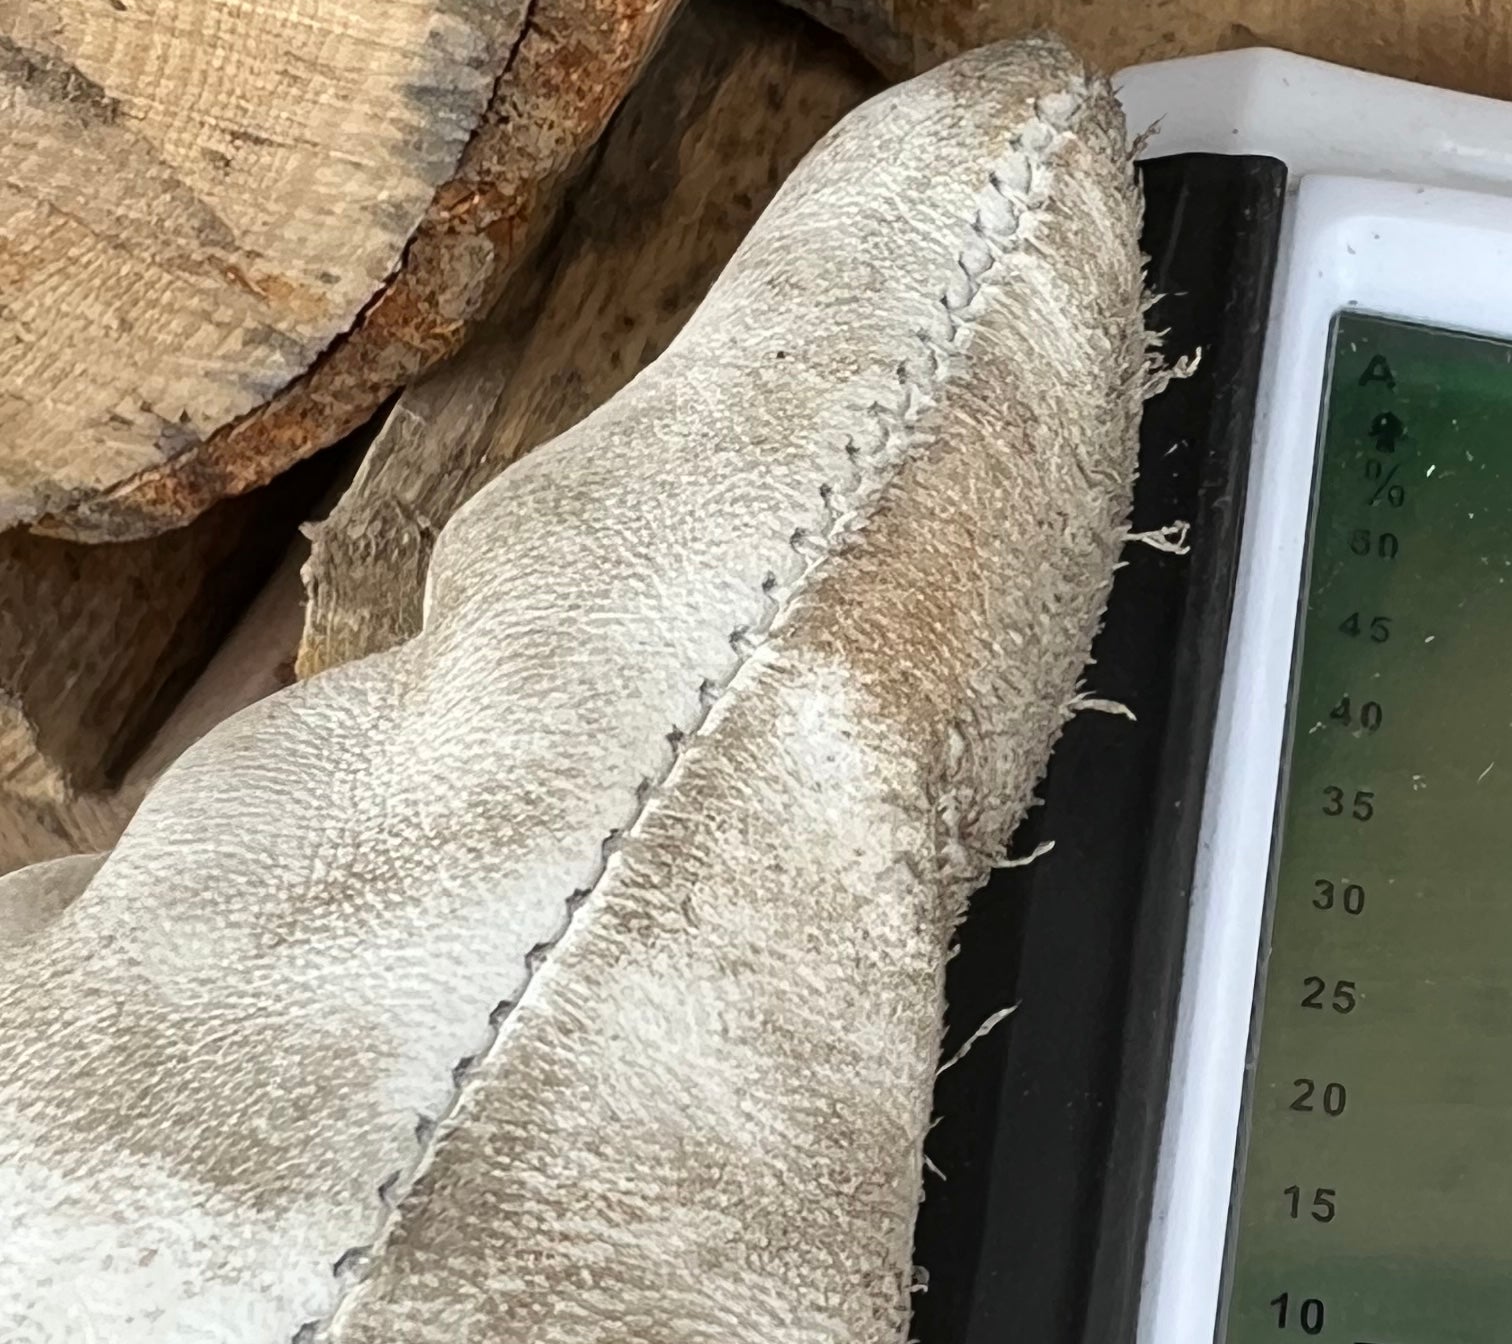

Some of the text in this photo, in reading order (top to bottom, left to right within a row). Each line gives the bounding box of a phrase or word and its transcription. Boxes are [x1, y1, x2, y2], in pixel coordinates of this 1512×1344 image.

[1358, 353, 1397, 390] A
[1338, 612, 1393, 644] 45
[1329, 695, 1384, 736] 40
[1321, 785, 1376, 823] 35
[1311, 878, 1365, 916] 30
[1300, 975, 1357, 1015] 25
[1288, 1077, 1348, 1117] 20
[1283, 1185, 1337, 1224] 15
[1269, 1291, 1326, 1336] 10
